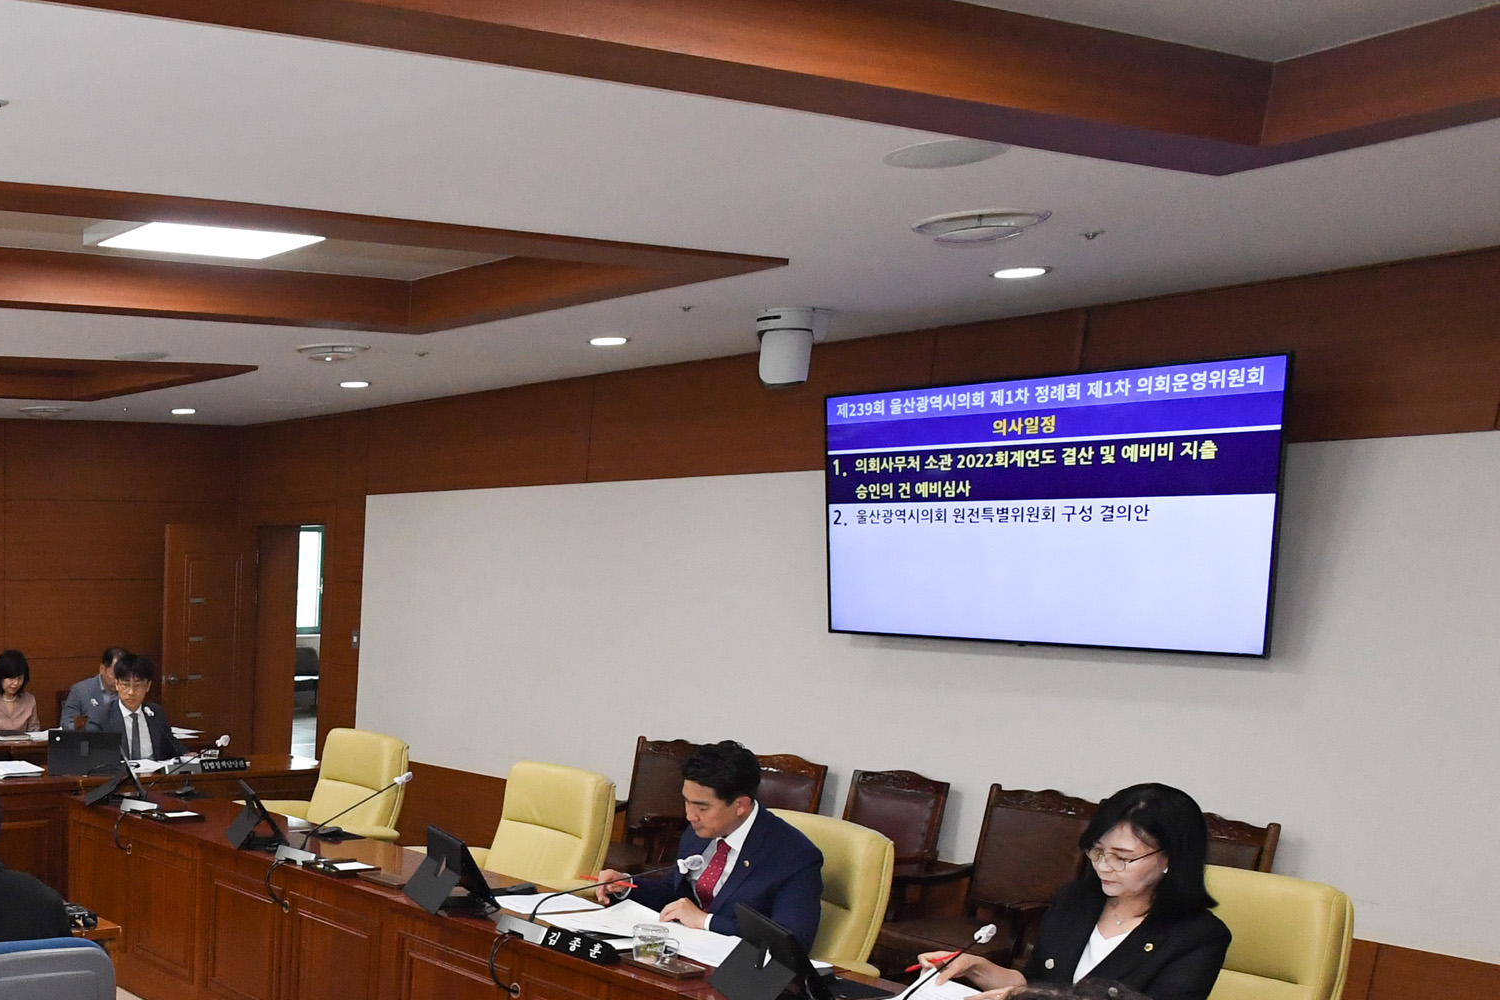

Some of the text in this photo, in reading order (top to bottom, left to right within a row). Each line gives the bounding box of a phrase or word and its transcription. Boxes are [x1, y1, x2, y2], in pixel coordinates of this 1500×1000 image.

[837, 365, 1264, 419] 제239회 울산광역시의회 제1차 정례회 제1차 의회운영위원회
[993, 414, 1057, 436] 의사일정
[832, 438, 1218, 477] 1. 의회사무처 소관 2022회계연도 결산 및 예비비 지출
[855, 479, 971, 500] 승인의 건 예비심사
[833, 504, 1150, 527] 2. 울산광역시의회 원전특별위원회 구성 결의안
